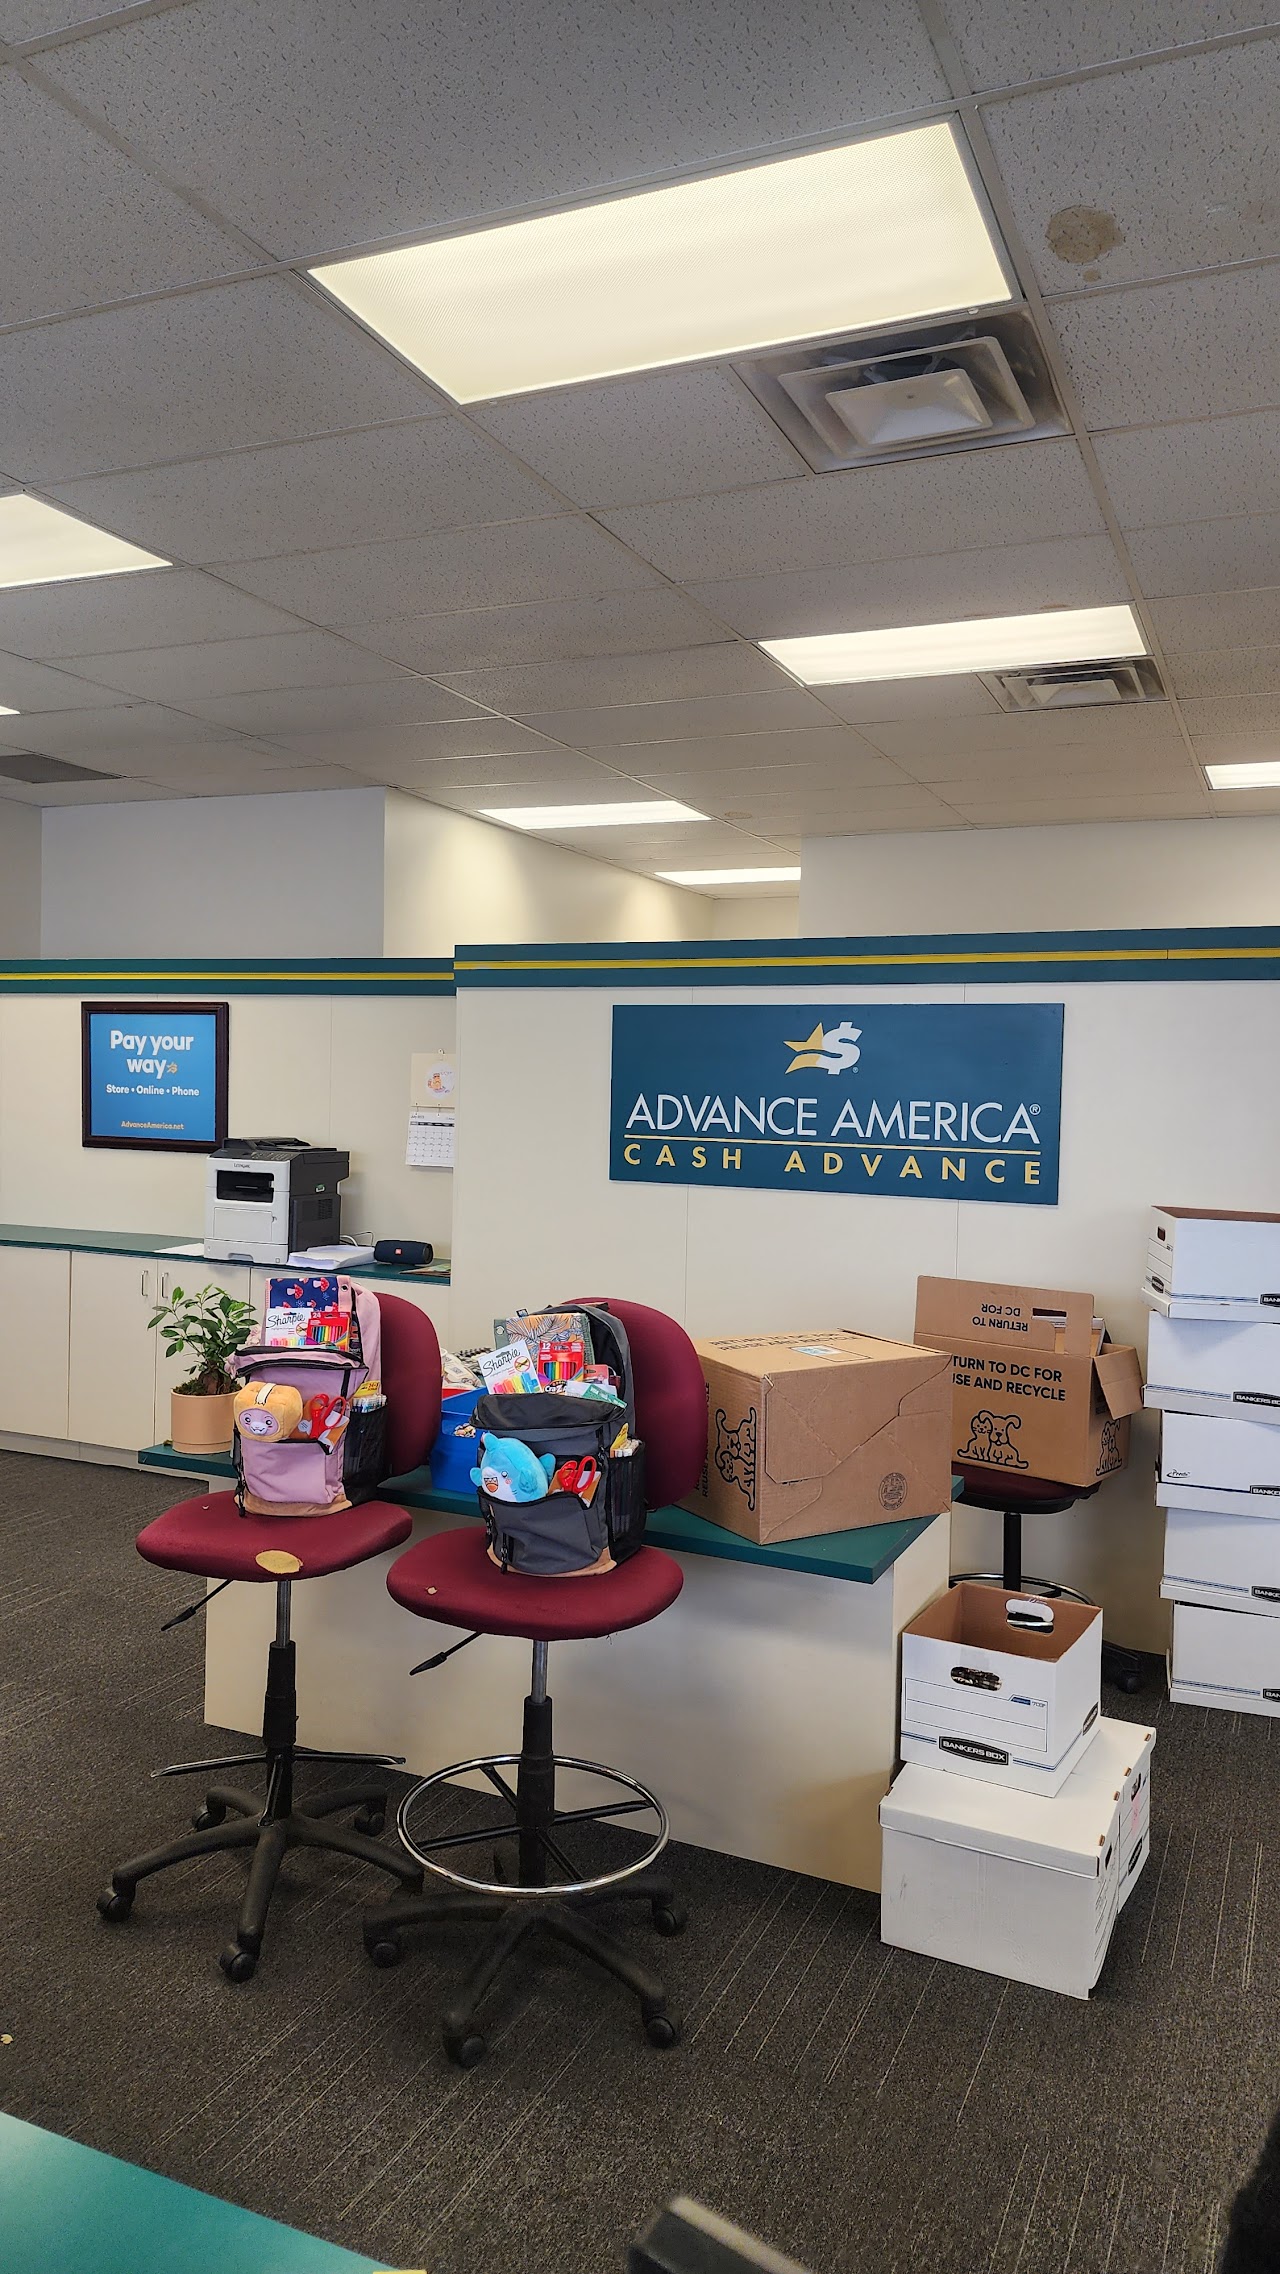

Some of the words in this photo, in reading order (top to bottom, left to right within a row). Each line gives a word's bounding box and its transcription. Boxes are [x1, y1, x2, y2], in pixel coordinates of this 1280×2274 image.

[110, 1030, 147, 1055] Pay
[150, 1035, 194, 1055] your
[127, 1059, 167, 1079] way
[106, 1084, 130, 1094] Store
[136, 1085, 164, 1095] Online
[172, 1086, 200, 1096] Phone
[625, 1092, 818, 1136] ADVANCE
[121, 1120, 185, 1130] AdvanceAmerica.net
[624, 1143, 742, 1170] CASH
[784, 1150, 1041, 1185] ADVANCE
[981, 1303, 1003, 1315] FOR
[1005, 1307, 1021, 1317] DC
[266, 1312, 306, 1328] Sharpie
[972, 1316, 987, 1326] TO
[988, 1318, 1028, 1332] RETURN
[542, 1342, 551, 1350] 12
[708, 1337, 767, 1346] RETURN
[718, 1343, 767, 1351] REUSE
[483, 1348, 521, 1377] Sharpie
[953, 1355, 985, 1371] TURN
[988, 1360, 1007, 1374] TO
[1011, 1363, 1030, 1378] DC
[1034, 1368, 1062, 1382] FOR
[974, 1377, 1002, 1391] AND
[1006, 1382, 1066, 1401] RECYCLE
[1236, 1395, 1270, 1403] BANKERS
[1252, 1488, 1280, 1496] BANKE
[943, 1740, 985, 1756] BANKERS
[986, 1752, 1005, 1761] BOX
